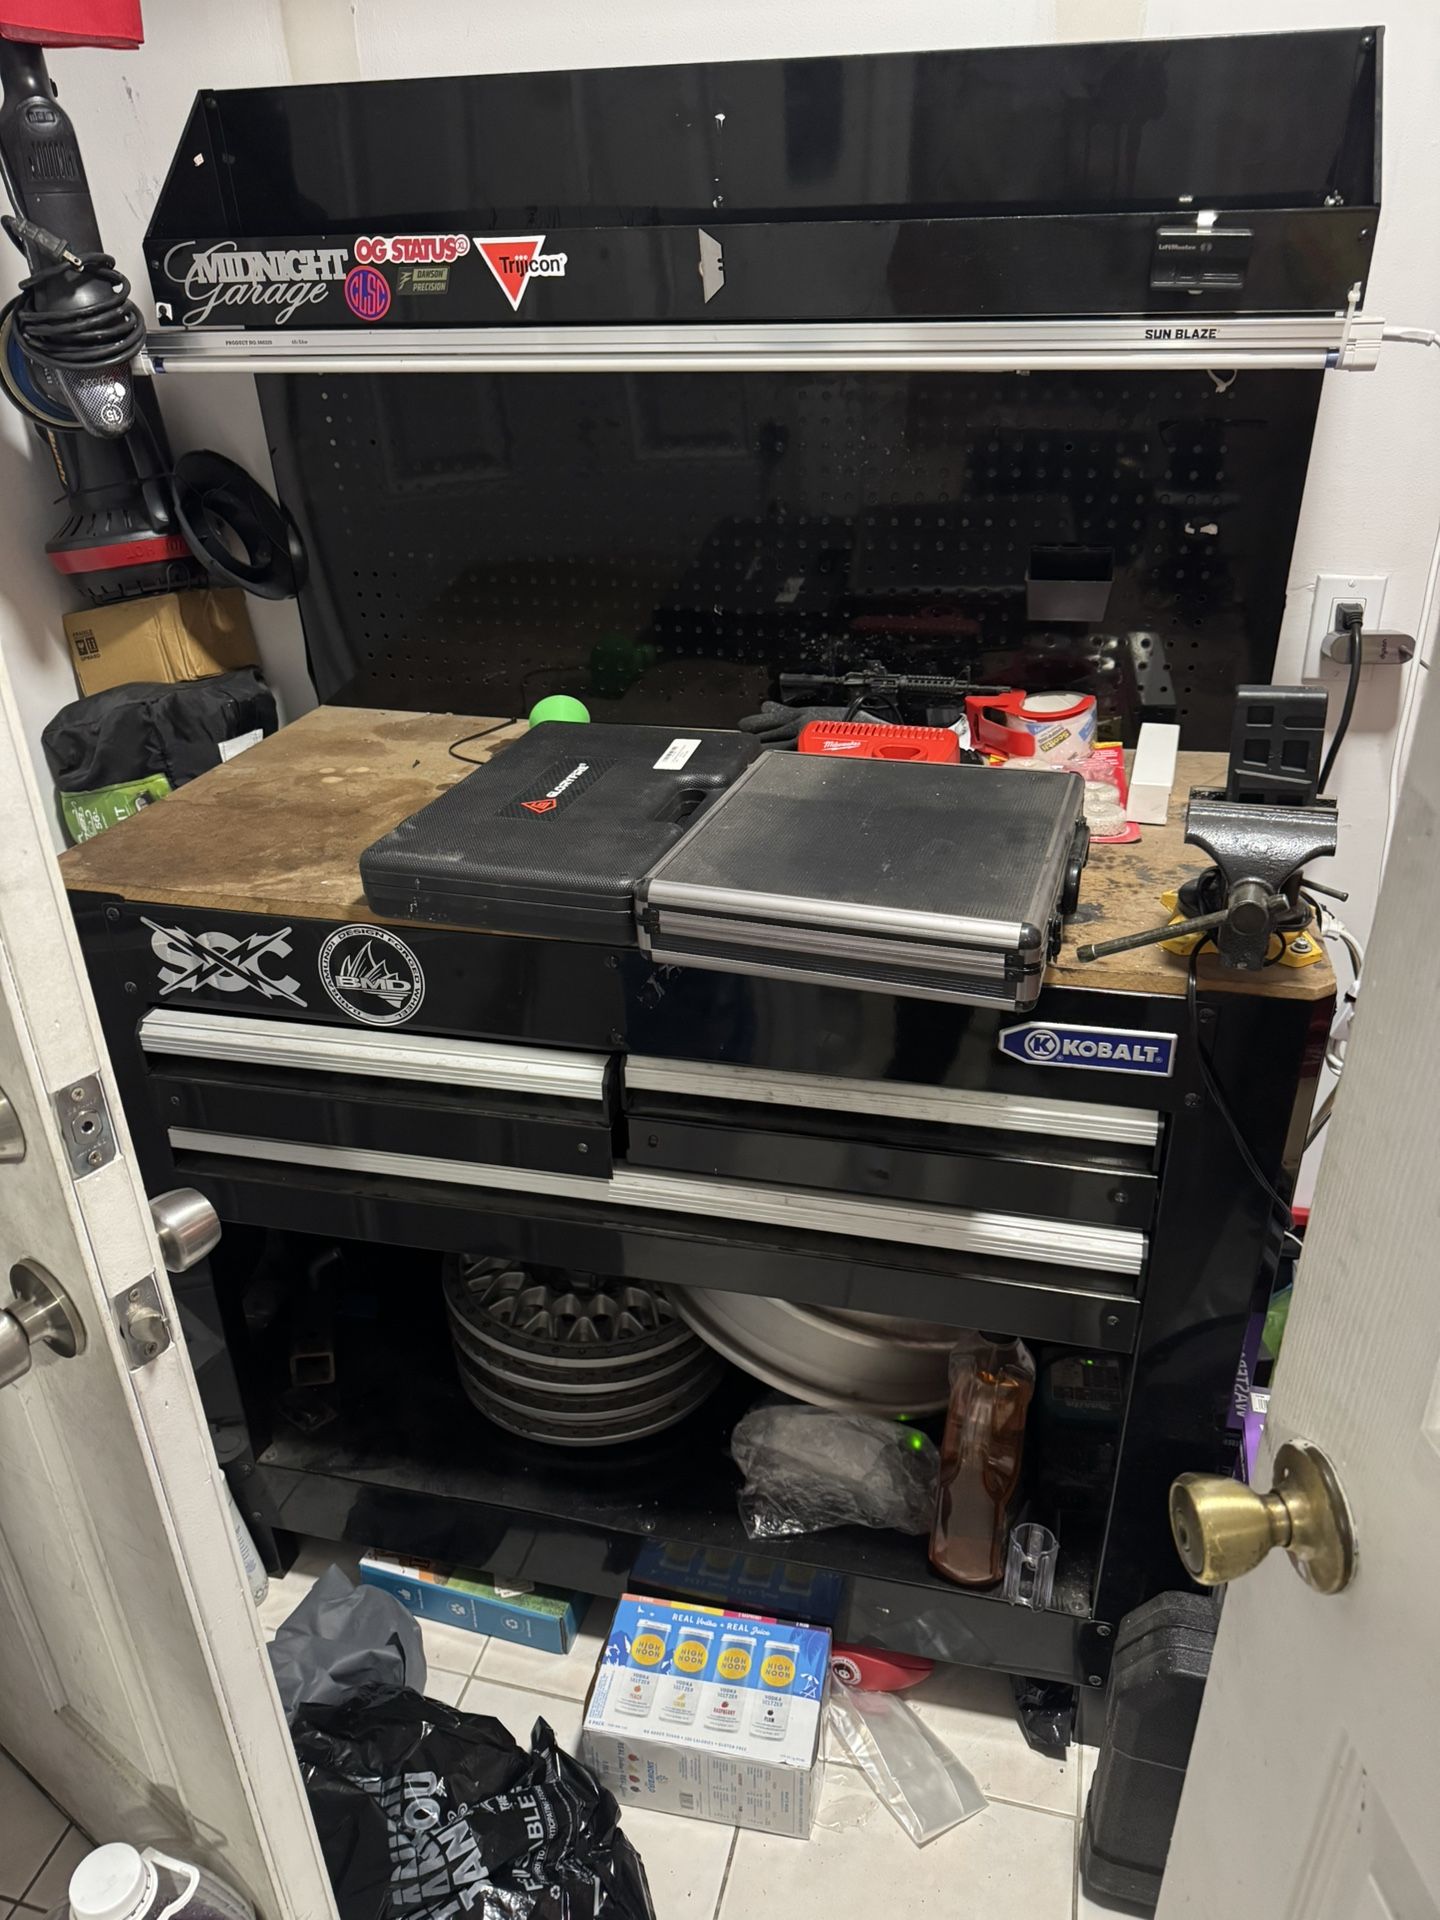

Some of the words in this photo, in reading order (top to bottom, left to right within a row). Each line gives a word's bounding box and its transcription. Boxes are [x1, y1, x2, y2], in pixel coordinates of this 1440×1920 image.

[356, 238, 387, 262] OG
[391, 237, 457, 262] STATUS
[192, 249, 349, 284] MIDNIGHT
[499, 255, 562, 277] Trijicon
[164, 241, 329, 326] Garage
[412, 281, 446, 292] PRECISION
[1145, 329, 1172, 339] SUN
[1174, 328, 1217, 339] BLAZE
[107, 410, 120, 421] 15
[823, 741, 862, 751] Milwaukee
[337, 928, 384, 940] DESIGN
[387, 937, 421, 984] FORGED
[335, 975, 412, 991] BMD
[395, 987, 421, 1018] WHEEL
[1062, 1038, 1160, 1063] KOBALT
[672, 1613, 694, 1623] REAL
[726, 1622, 749, 1633] REAL
[750, 1625, 771, 1636] Juice
[639, 1641, 661, 1651] HIGH
[635, 1647, 661, 1659] NOON
[681, 1648, 703, 1658] HIGH
[678, 1654, 703, 1665] NOON
[723, 1655, 747, 1665] HIGH
[721, 1661, 747, 1672] NOON
[767, 1662, 791, 1672] HIGH
[765, 1668, 791, 1679] NOON
